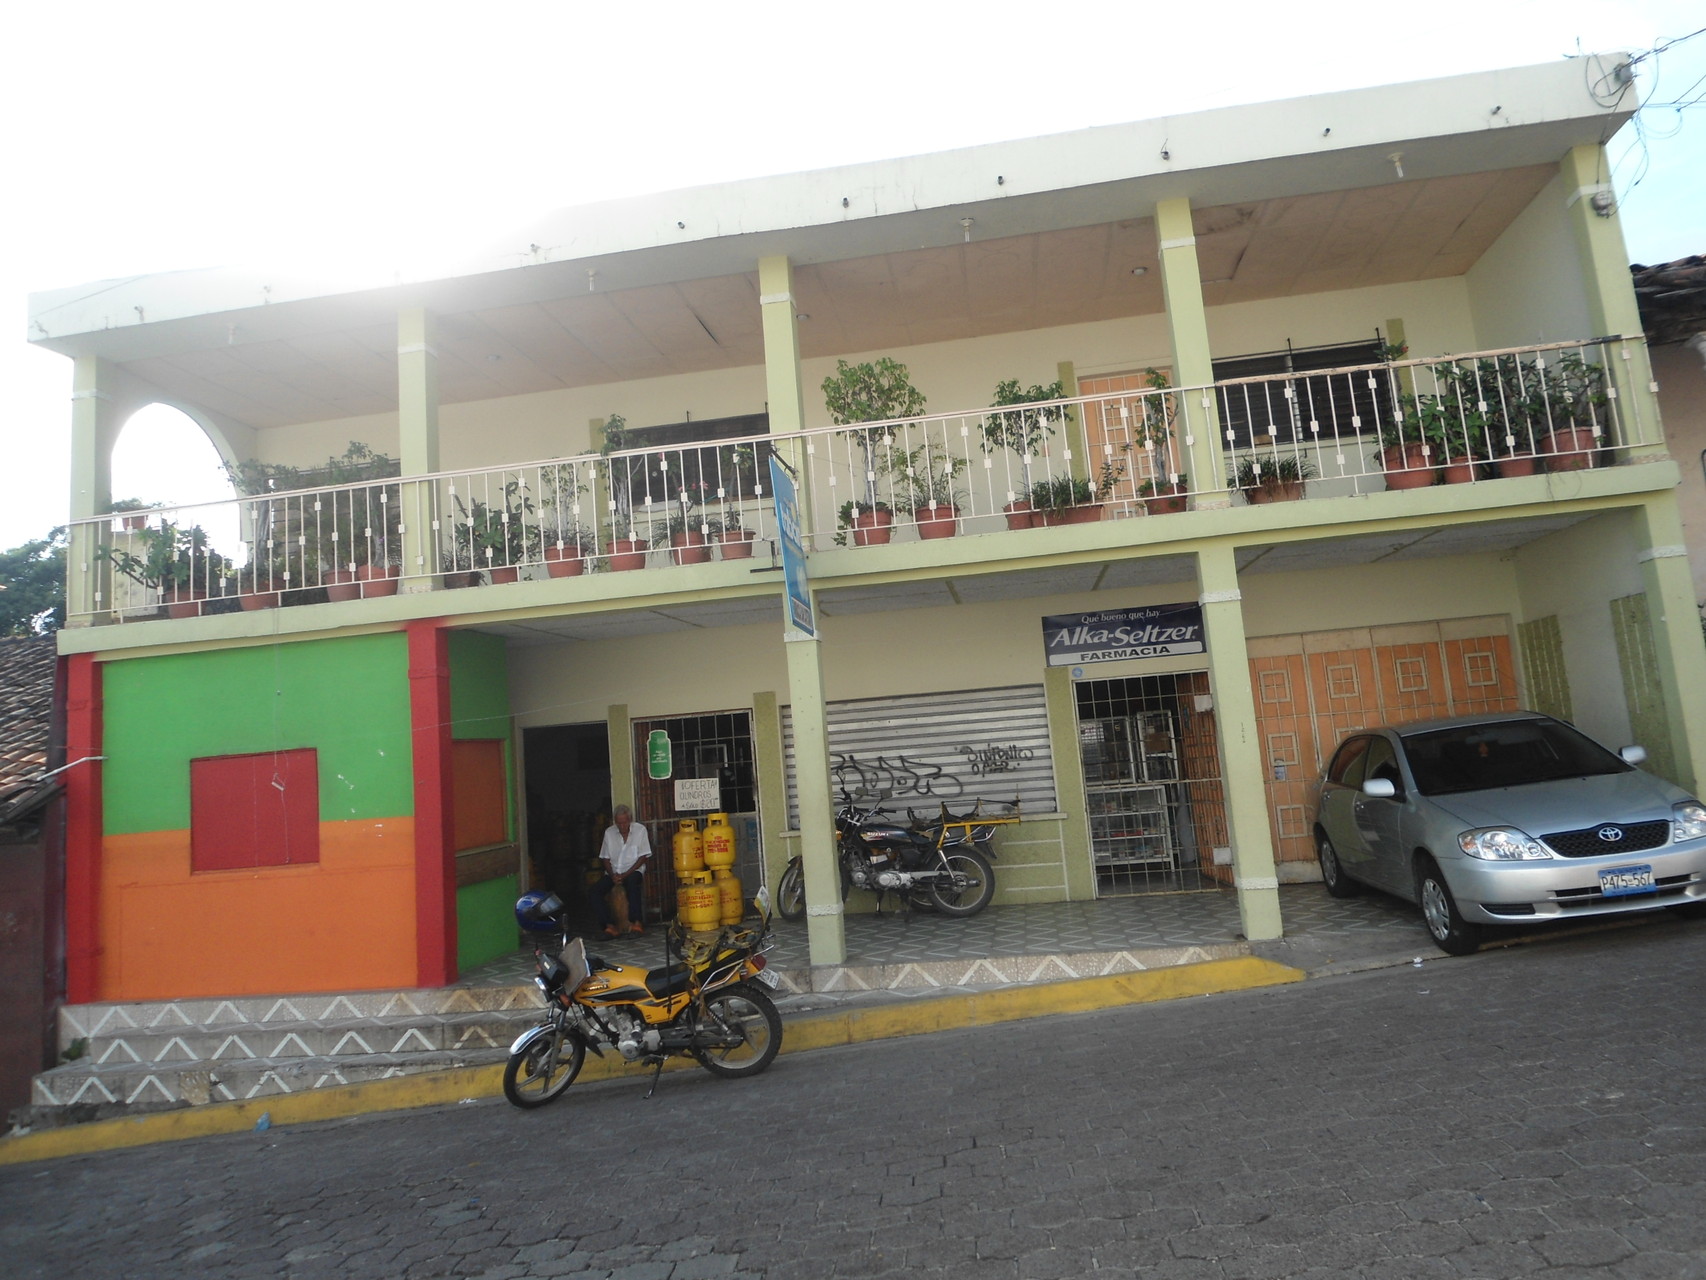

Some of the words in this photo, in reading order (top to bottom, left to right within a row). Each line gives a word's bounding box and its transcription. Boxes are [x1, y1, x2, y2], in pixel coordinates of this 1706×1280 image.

[1081, 614, 1100, 624] Qué
[1101, 613, 1127, 622] bueno
[1128, 611, 1145, 620] que
[1145, 609, 1161, 619] hay
[1050, 624, 1199, 648] Alka-Seltzer
[1080, 645, 1171, 662] FARMACIA
